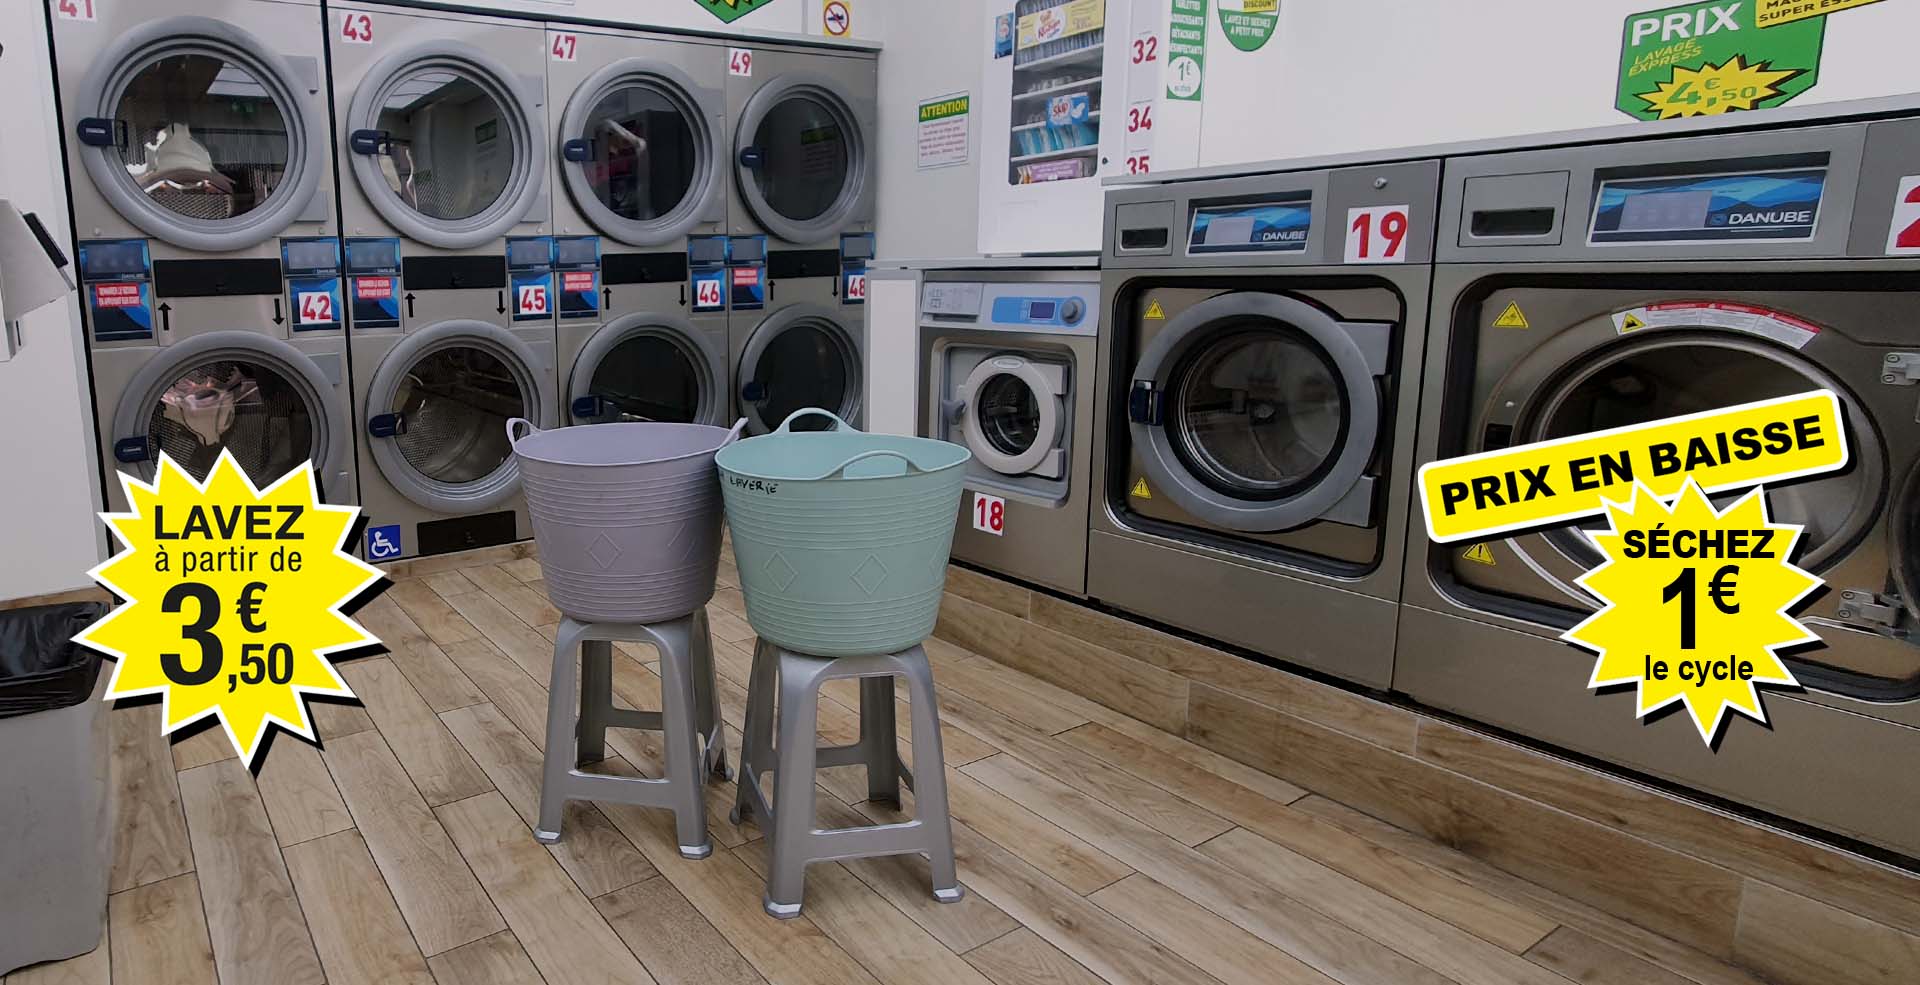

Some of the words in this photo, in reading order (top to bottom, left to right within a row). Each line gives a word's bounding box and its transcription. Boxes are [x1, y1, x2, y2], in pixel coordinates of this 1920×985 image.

[59, 0, 93, 18] 41
[1759, 4, 1815, 22] SUPER
[342, 14, 373, 42] 43
[1631, 2, 1742, 47] PRIX
[552, 35, 576, 59] 47
[1133, 36, 1157, 64] 32
[1635, 37, 1697, 65] LAVAGE
[730, 51, 751, 74] 49
[1629, 45, 1703, 77] EXPRESS
[921, 98, 968, 119] ATTENTION
[1128, 105, 1152, 132] 34
[1126, 155, 1150, 175] 35
[1729, 210, 1812, 225] DANUBE
[1262, 230, 1306, 241] DANUBE
[1351, 211, 1408, 259] 19
[699, 283, 720, 303] 46
[849, 277, 864, 297] 48
[302, 294, 332, 320] 42
[521, 288, 545, 311] 45
[977, 497, 1004, 531] 18
